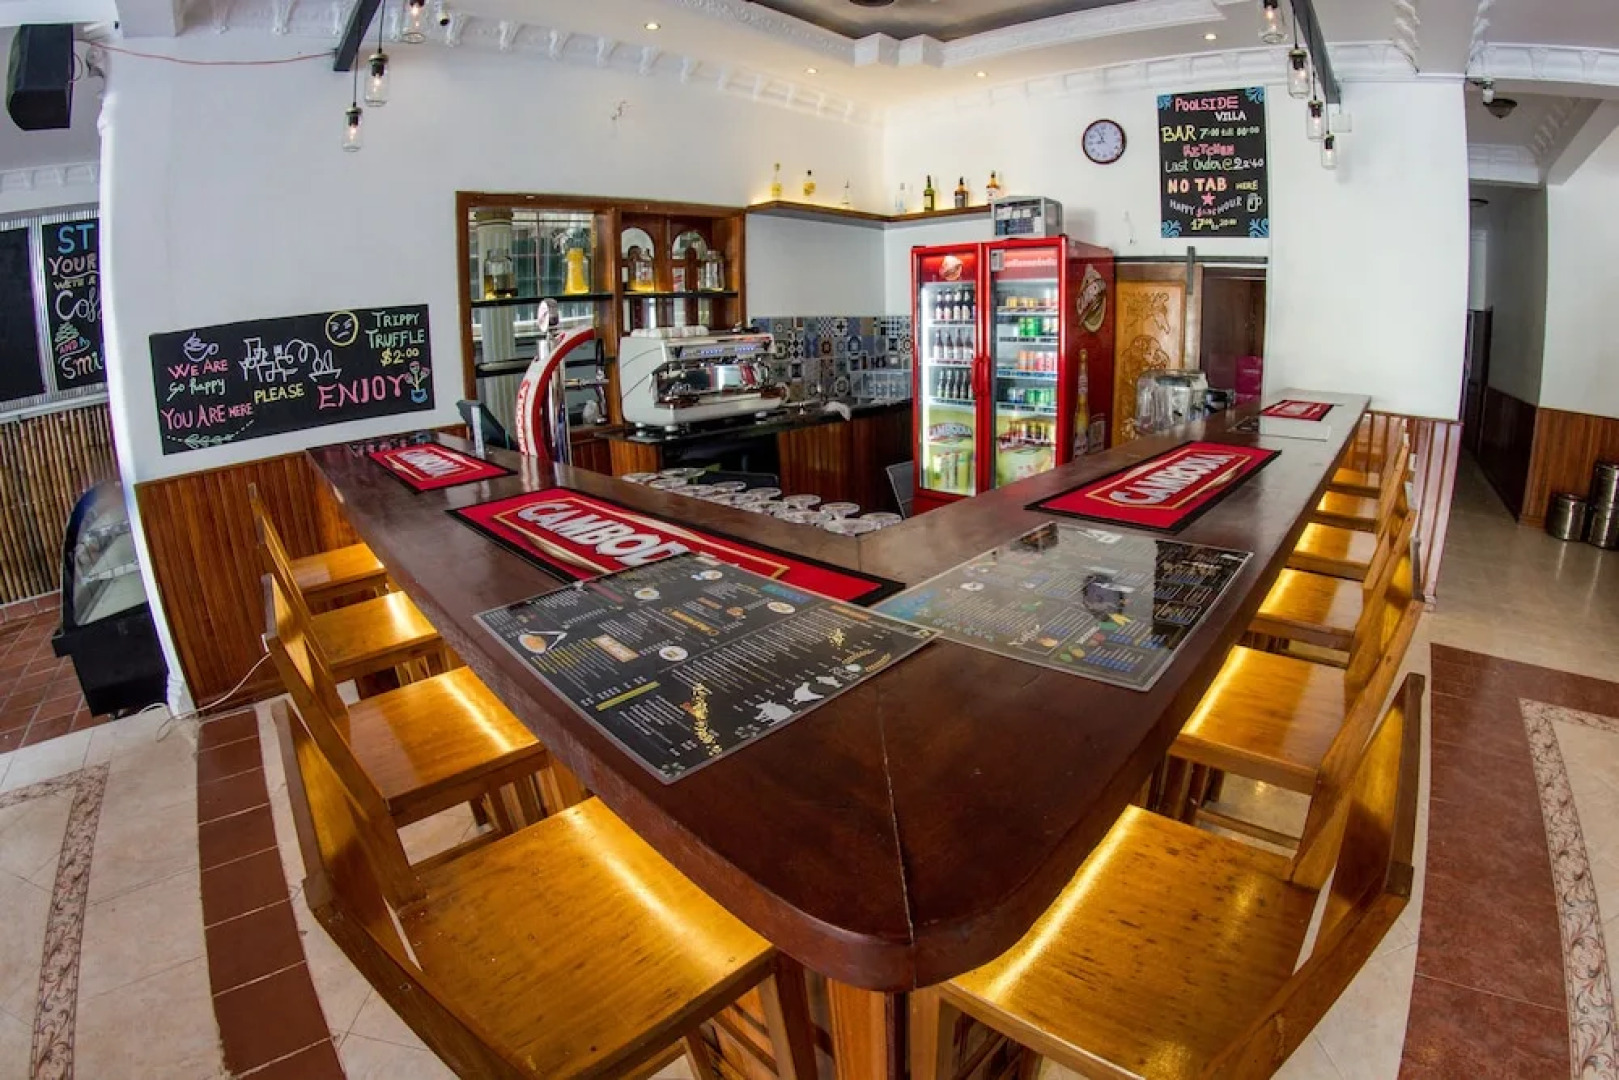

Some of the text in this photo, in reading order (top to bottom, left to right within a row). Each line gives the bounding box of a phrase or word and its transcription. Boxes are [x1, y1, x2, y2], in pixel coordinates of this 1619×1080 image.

[1175, 95, 1239, 112] POOLSIDE
[1215, 111, 1247, 122] VILLA
[1161, 125, 1196, 142] BAR
[1165, 160, 1189, 173] Last
[1167, 178, 1190, 194] NO
[1194, 177, 1228, 191] TAB
[371, 311, 420, 328] TRIPPY
[365, 329, 425, 349] TRUFFLE
[167, 359, 229, 379] WE ARE
[254, 382, 305, 405] PLEASE
[317, 373, 405, 410] ENJOY
[160, 402, 254, 430] YOU ARE HERE
[1109, 453, 1238, 505] CAMBODIA
